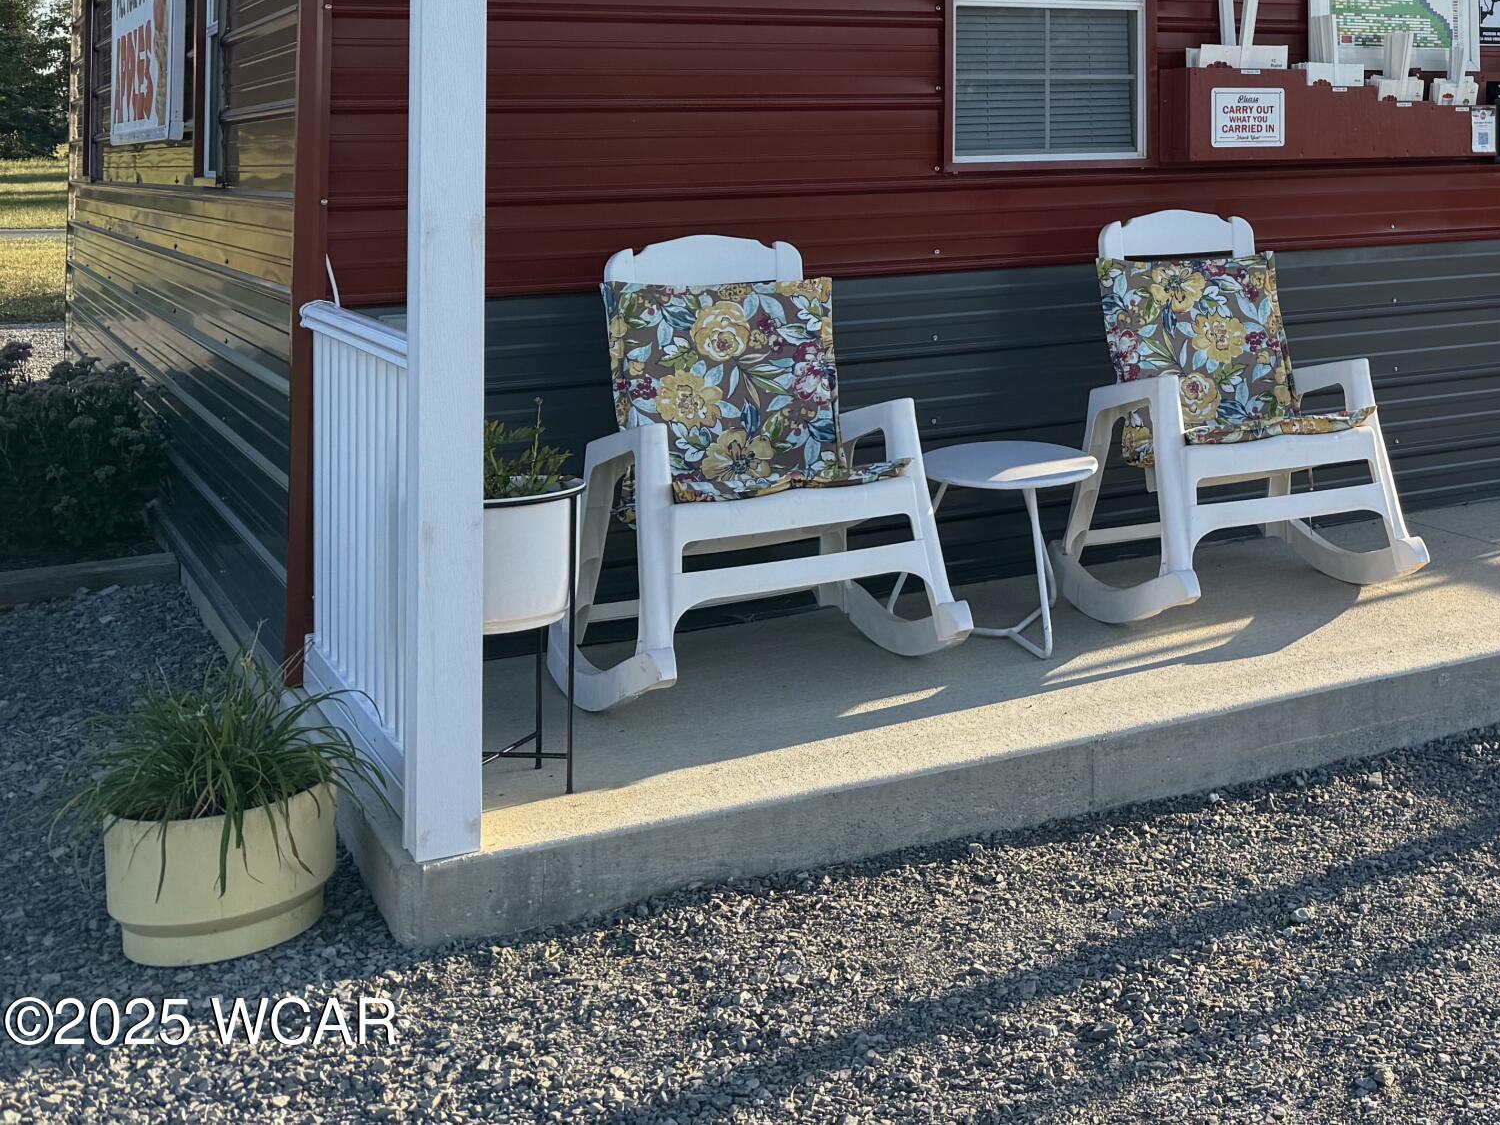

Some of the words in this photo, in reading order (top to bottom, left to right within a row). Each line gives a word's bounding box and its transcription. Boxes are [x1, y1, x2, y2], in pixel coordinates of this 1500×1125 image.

[1237, 94, 1259, 103] Please
[1222, 105, 1254, 114] CARRY
[1256, 105, 1274, 114] OUT
[1229, 115, 1251, 123] WHAT
[1252, 115, 1268, 123] YOU
[1221, 124, 1263, 133] CARRIED
[1265, 124, 1275, 133] IN
